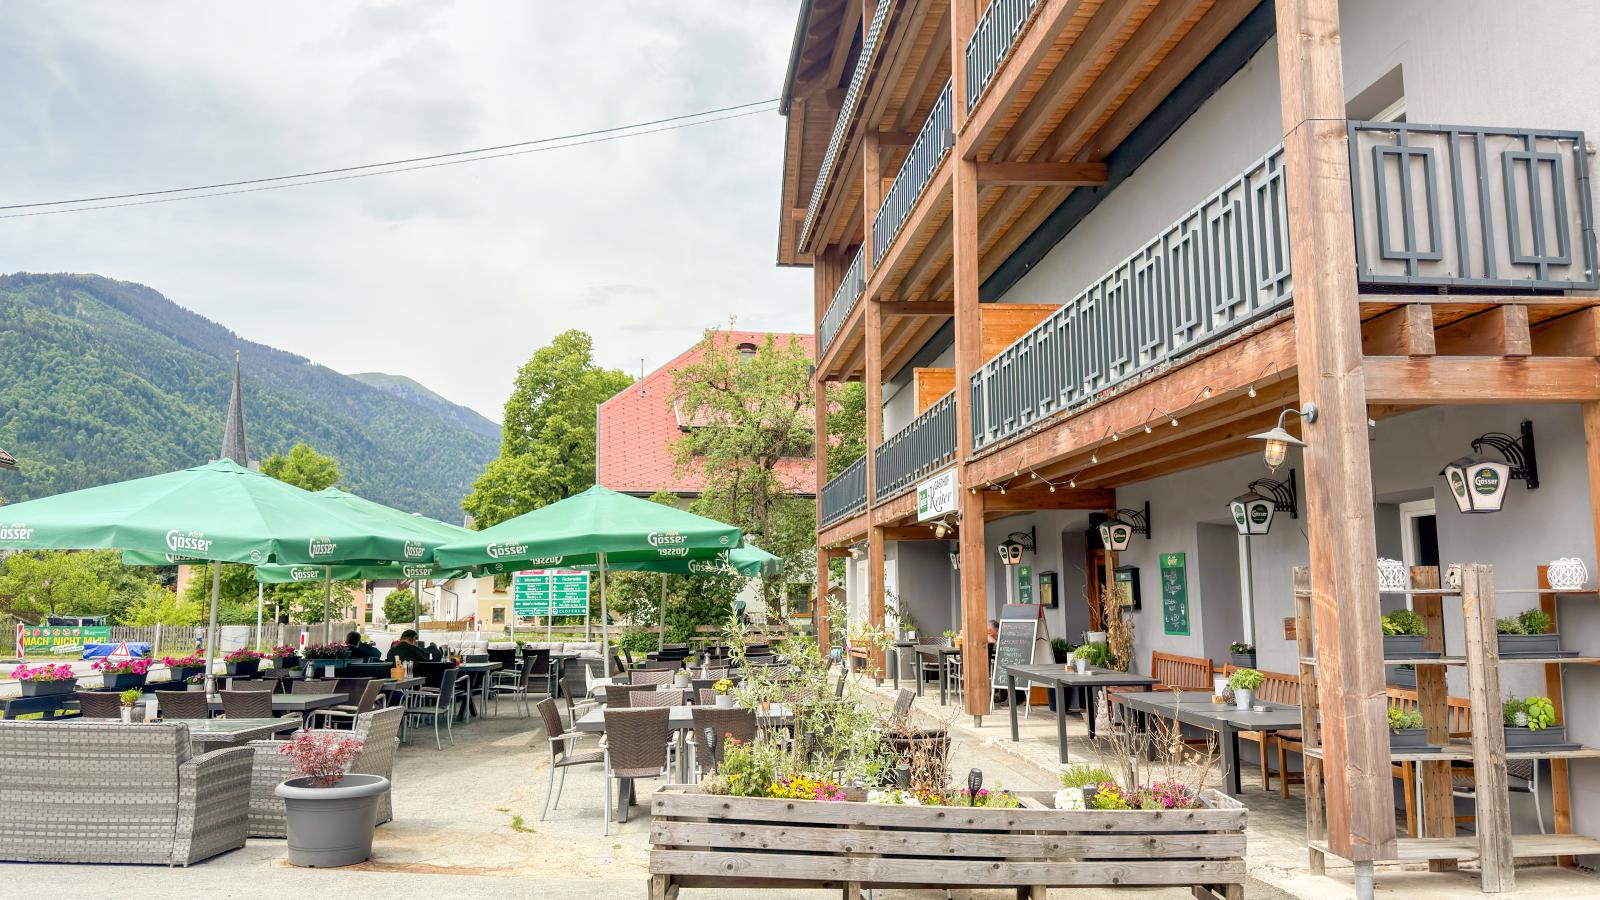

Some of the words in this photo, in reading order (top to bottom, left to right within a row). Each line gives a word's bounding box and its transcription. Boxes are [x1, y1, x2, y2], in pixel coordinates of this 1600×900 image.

[1475, 476, 1498, 486] Gösser
[928, 486, 952, 512] Reiter
[0, 522, 34, 540] össer
[648, 531, 687, 547] Gösser
[165, 529, 212, 552] Gösser
[309, 537, 336, 559] Gösser
[404, 540, 425, 559] Gösser
[487, 543, 528, 559] Gösser
[290, 567, 319, 581] Gösser
[403, 564, 432, 578] Gösser
[53, 637, 80, 646] NICHT
